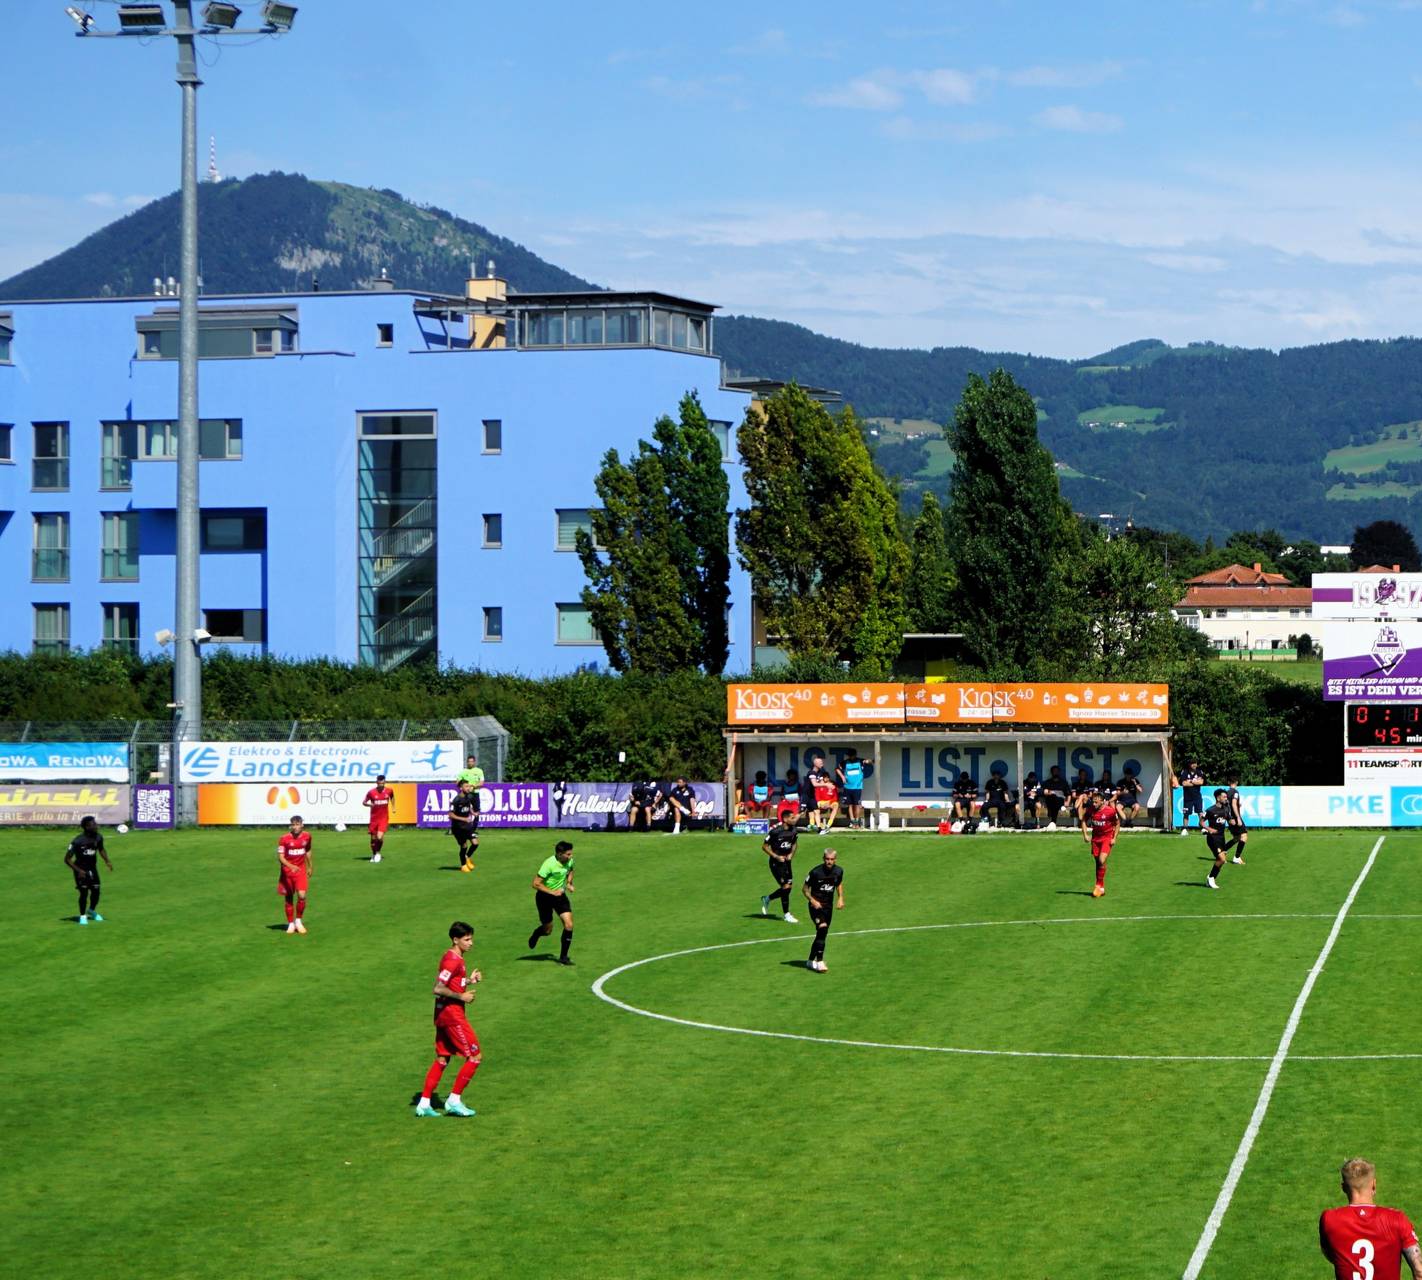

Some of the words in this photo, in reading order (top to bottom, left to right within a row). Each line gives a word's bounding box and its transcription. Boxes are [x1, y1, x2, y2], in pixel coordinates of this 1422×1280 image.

[1328, 685, 1342, 695] ES
[1345, 685, 1365, 695] IST
[1367, 685, 1396, 695] DEIN
[1356, 706, 1369, 723] 0
[1375, 727, 1401, 744] 45
[229, 746, 281, 756] Elektro
[285, 746, 294, 756] &
[299, 745, 369, 756] Electronic
[225, 758, 396, 777] Landsteiner
[902, 746, 986, 788] LIST
[1034, 746, 1119, 785] LIST
[306, 788, 348, 805] URO
[422, 788, 543, 812] ABOLUT
[1328, 795, 1384, 814] PKE
[423, 814, 449, 822] PRIDE
[508, 814, 543, 822] PASSION
[1351, 1238, 1375, 1280] 3
